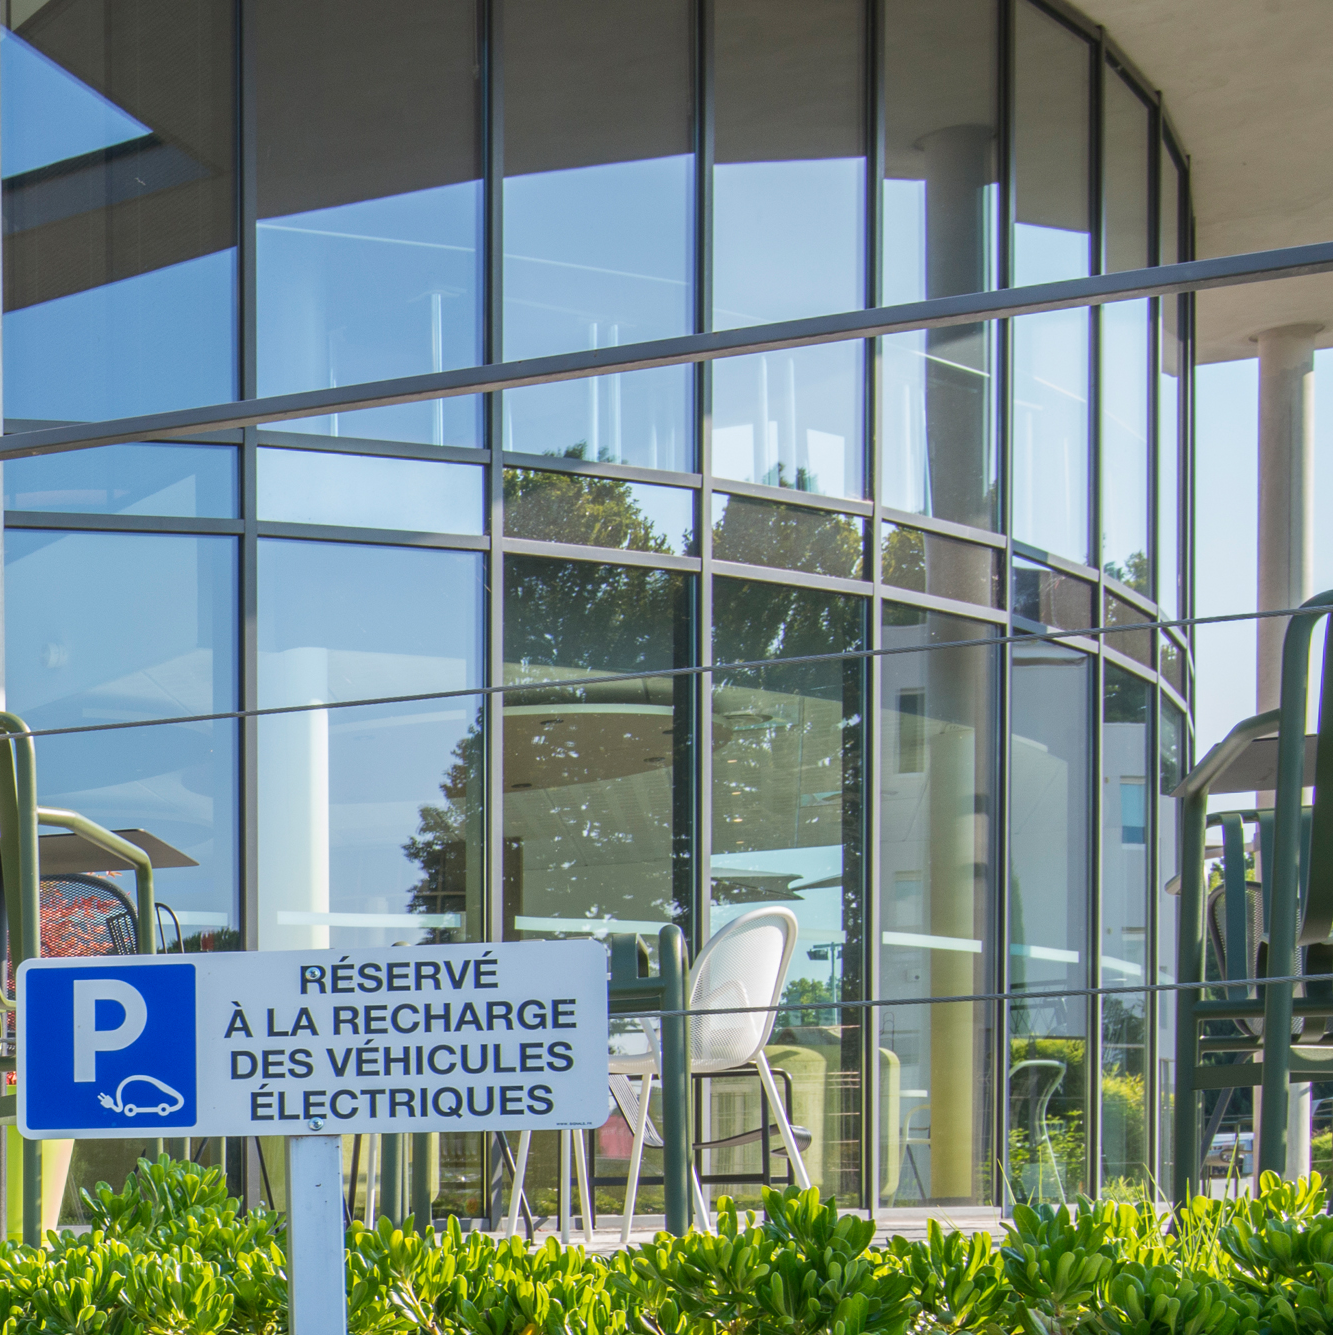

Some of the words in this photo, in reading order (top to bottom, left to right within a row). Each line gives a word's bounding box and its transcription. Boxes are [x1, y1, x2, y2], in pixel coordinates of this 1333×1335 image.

[300, 951, 499, 994] RÉSERVÉ
[73, 978, 148, 1083] P
[224, 1001, 253, 1038] À
[267, 1007, 319, 1037] LA
[333, 998, 577, 1036] RECHARGE
[231, 1048, 314, 1080] DES
[326, 1039, 575, 1078] VÉHICULES
[250, 1083, 555, 1121] ÉLECTRIQUES
